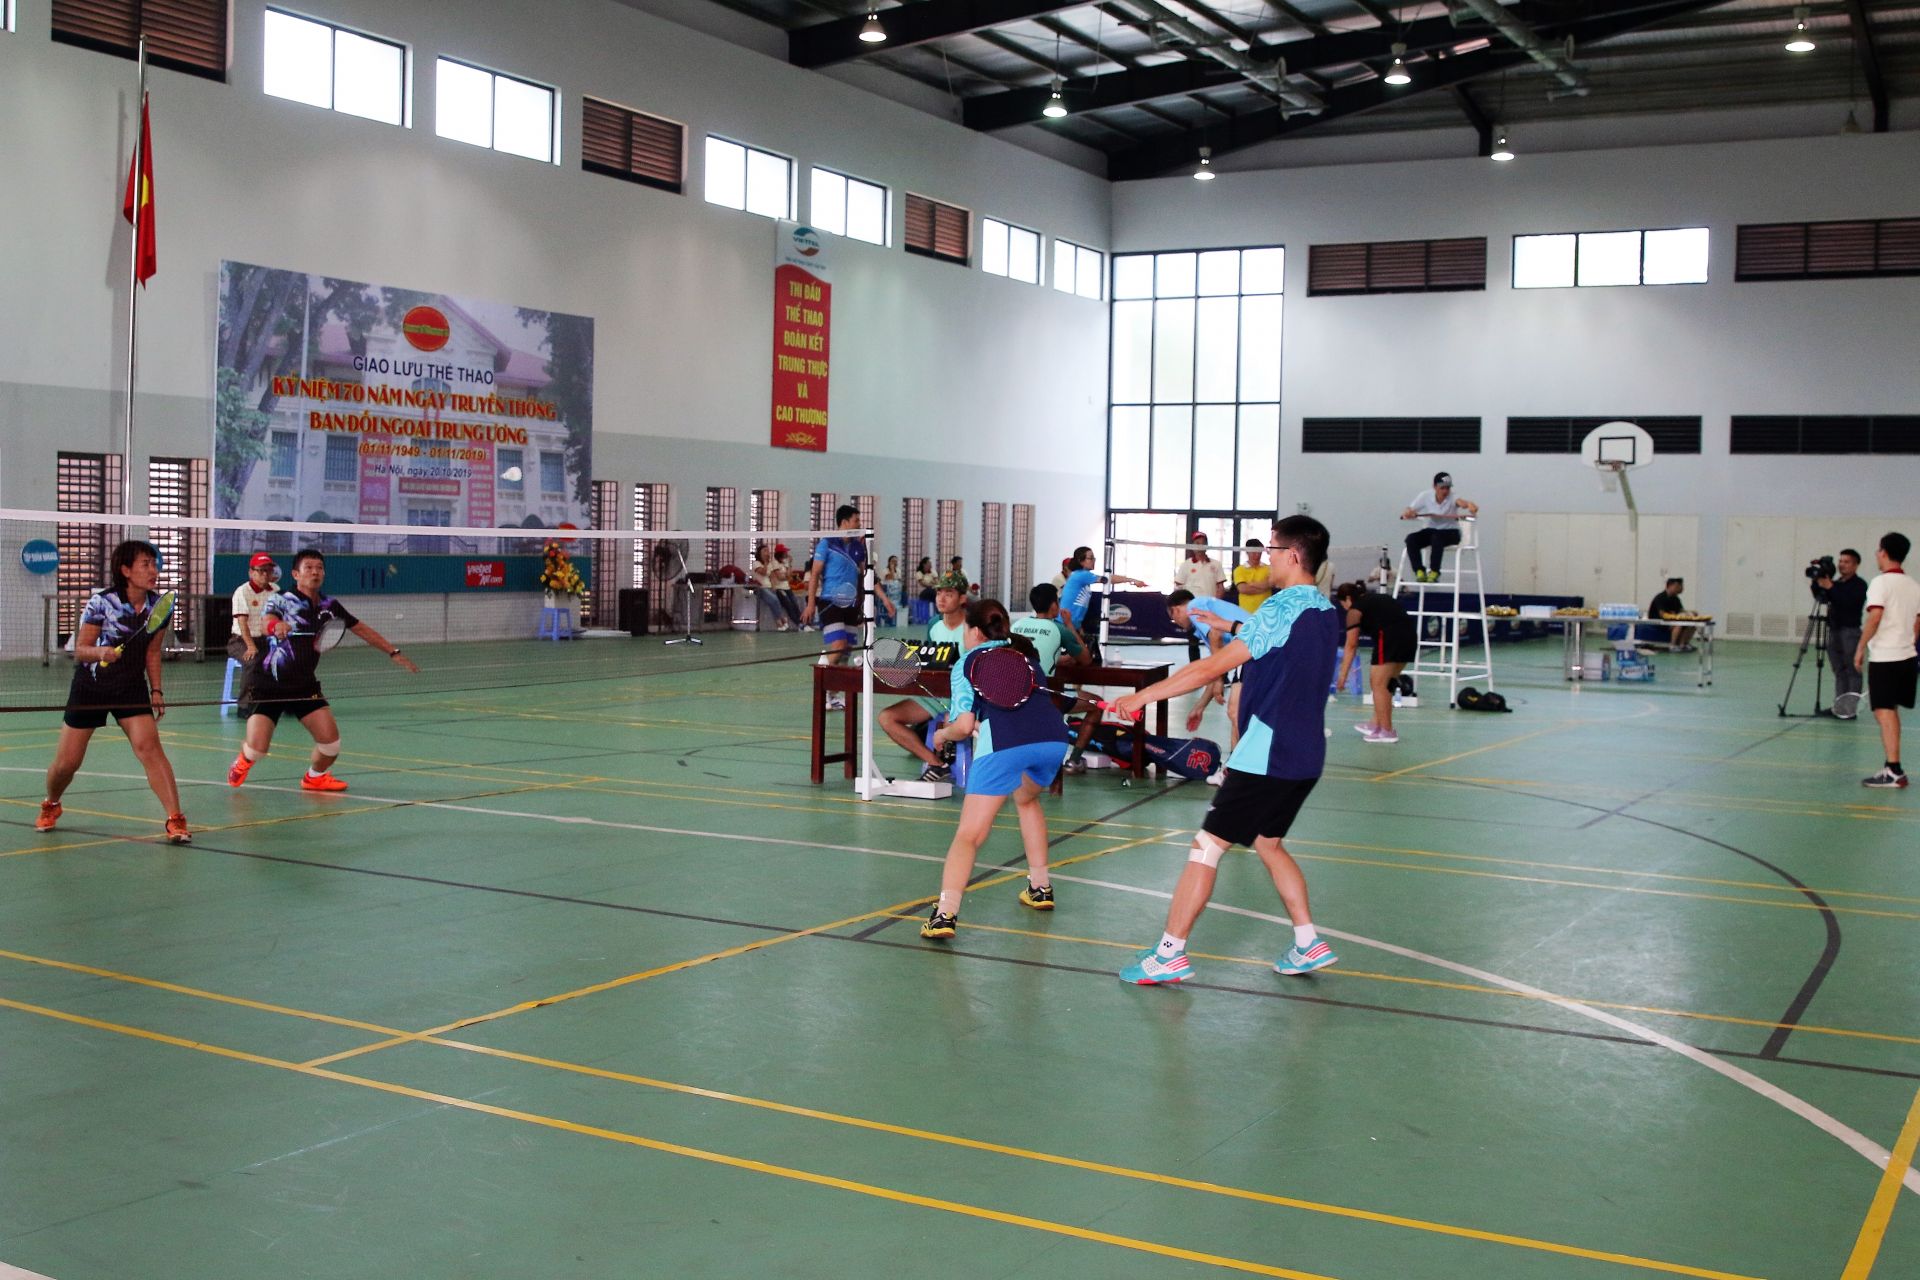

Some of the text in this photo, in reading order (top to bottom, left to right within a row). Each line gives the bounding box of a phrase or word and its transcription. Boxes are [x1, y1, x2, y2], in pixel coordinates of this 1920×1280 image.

[789, 280, 803, 298] THI
[802, 308, 824, 327] THAO
[353, 356, 389, 374] GIAO
[393, 360, 423, 377] LƯU
[457, 367, 494, 385] THAO
[778, 354, 806, 374] TRUNG
[343, 383, 365, 402] 70
[776, 405, 793, 422] CAO
[310, 410, 345, 430] BAN
[434, 421, 484, 441] TRUNG
[936, 646, 951, 662] 11
